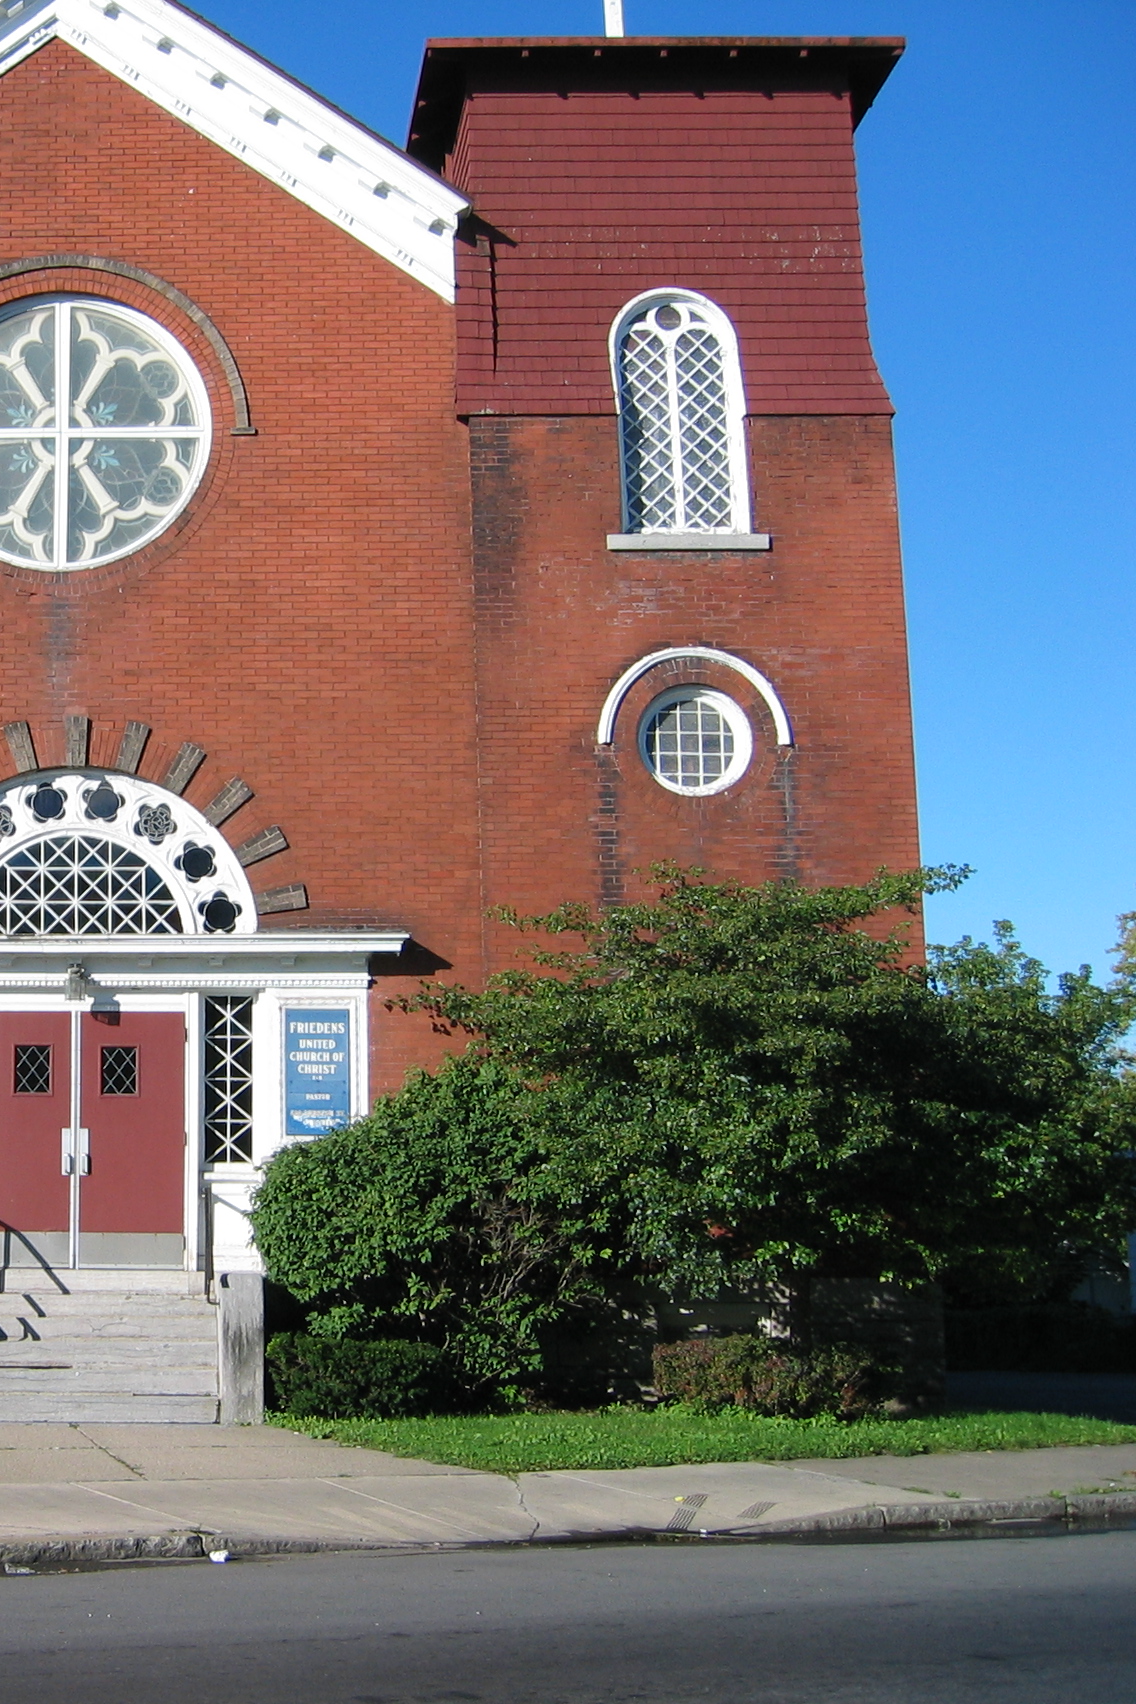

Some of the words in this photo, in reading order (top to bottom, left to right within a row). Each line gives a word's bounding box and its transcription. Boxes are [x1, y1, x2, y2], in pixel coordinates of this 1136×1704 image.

[289, 1022, 345, 1034] FRIEDENS
[298, 1039, 336, 1050] UNITED
[289, 1052, 330, 1062] CHURCH
[332, 1052, 345, 1062] OF
[297, 1064, 337, 1075] CHRIST
